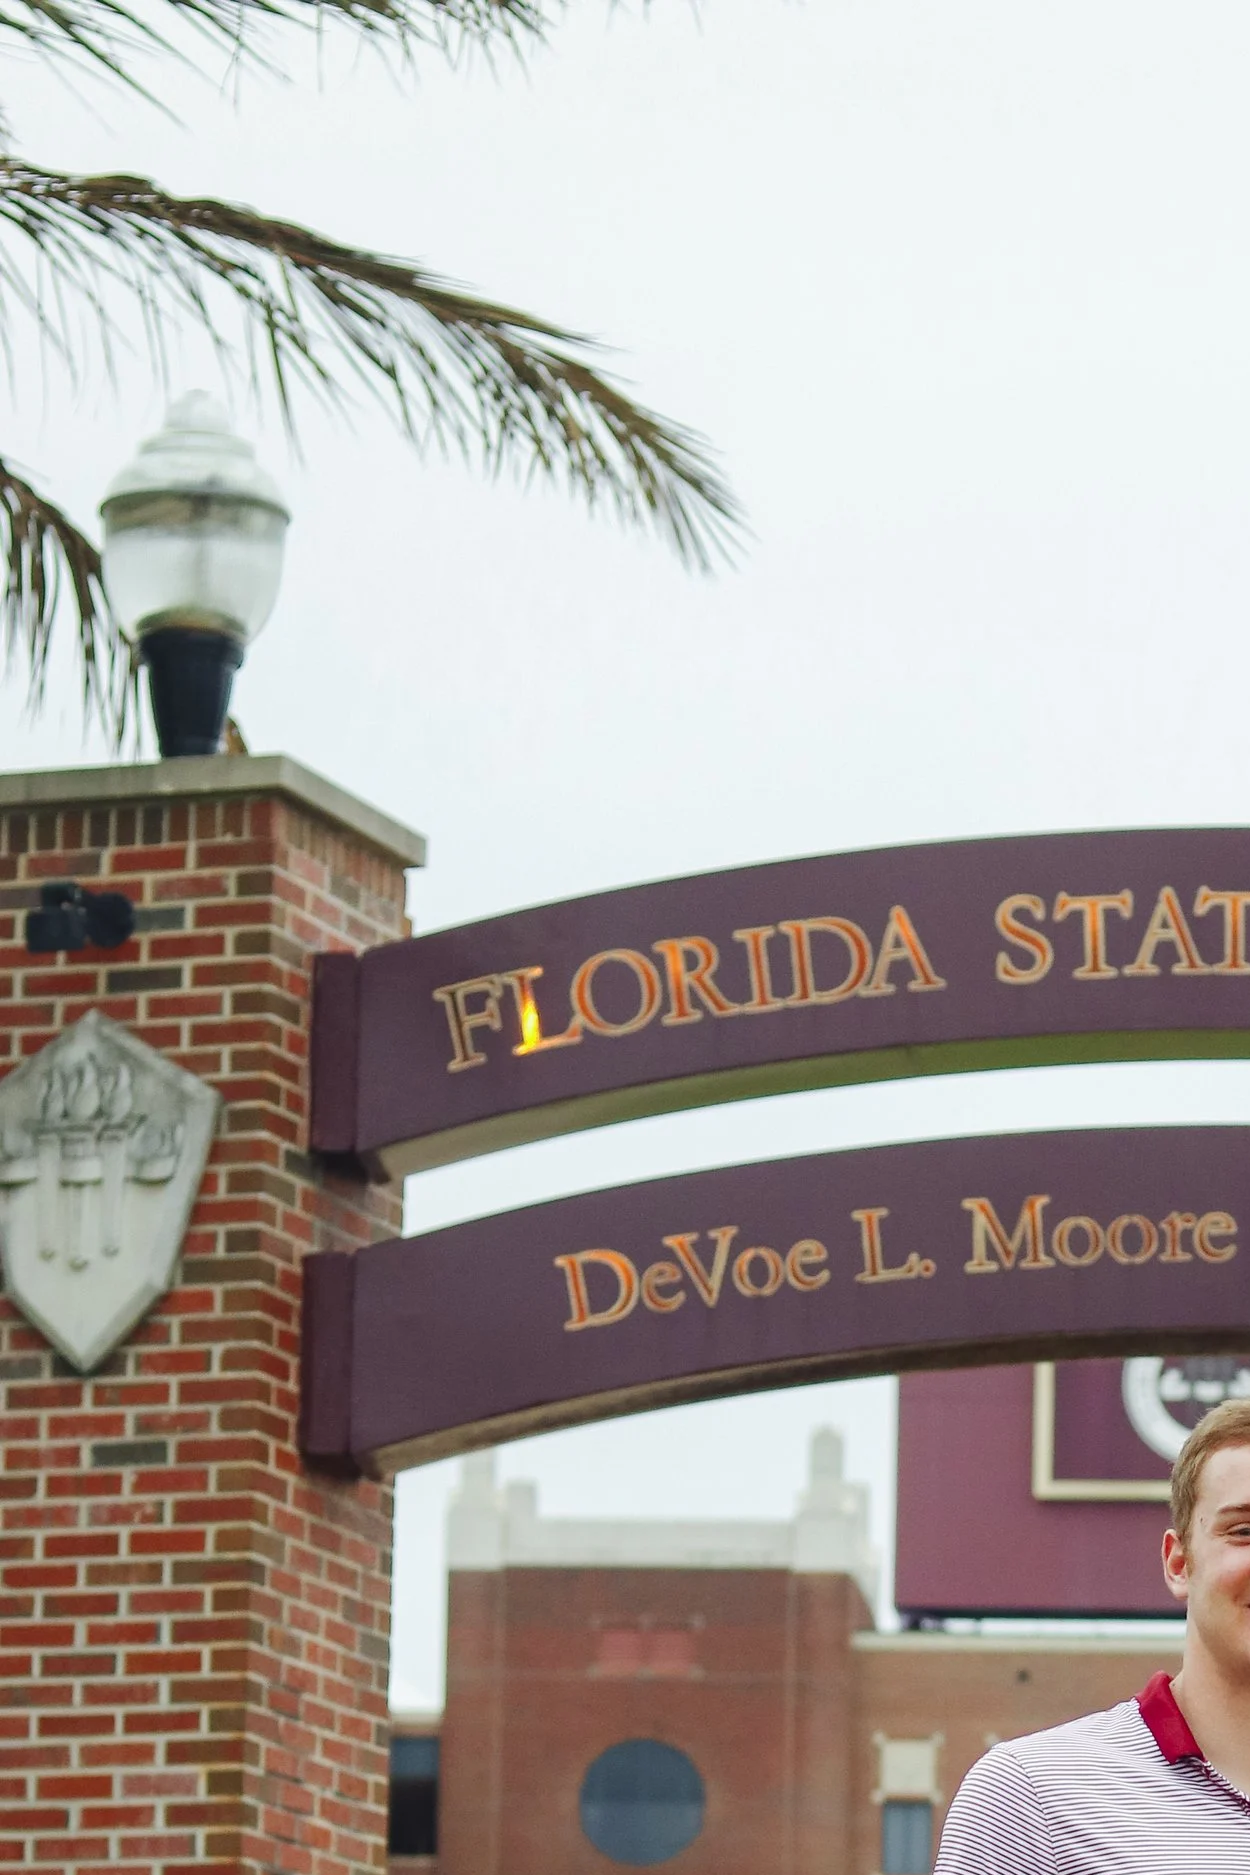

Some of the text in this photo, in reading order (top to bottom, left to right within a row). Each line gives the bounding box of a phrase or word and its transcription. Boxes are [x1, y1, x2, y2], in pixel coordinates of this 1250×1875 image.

[434, 904, 946, 1073] FLORIDA
[555, 1226, 831, 1332] DeVoe
[853, 1208, 936, 1282] L.
[962, 1194, 1238, 1274] Moore
